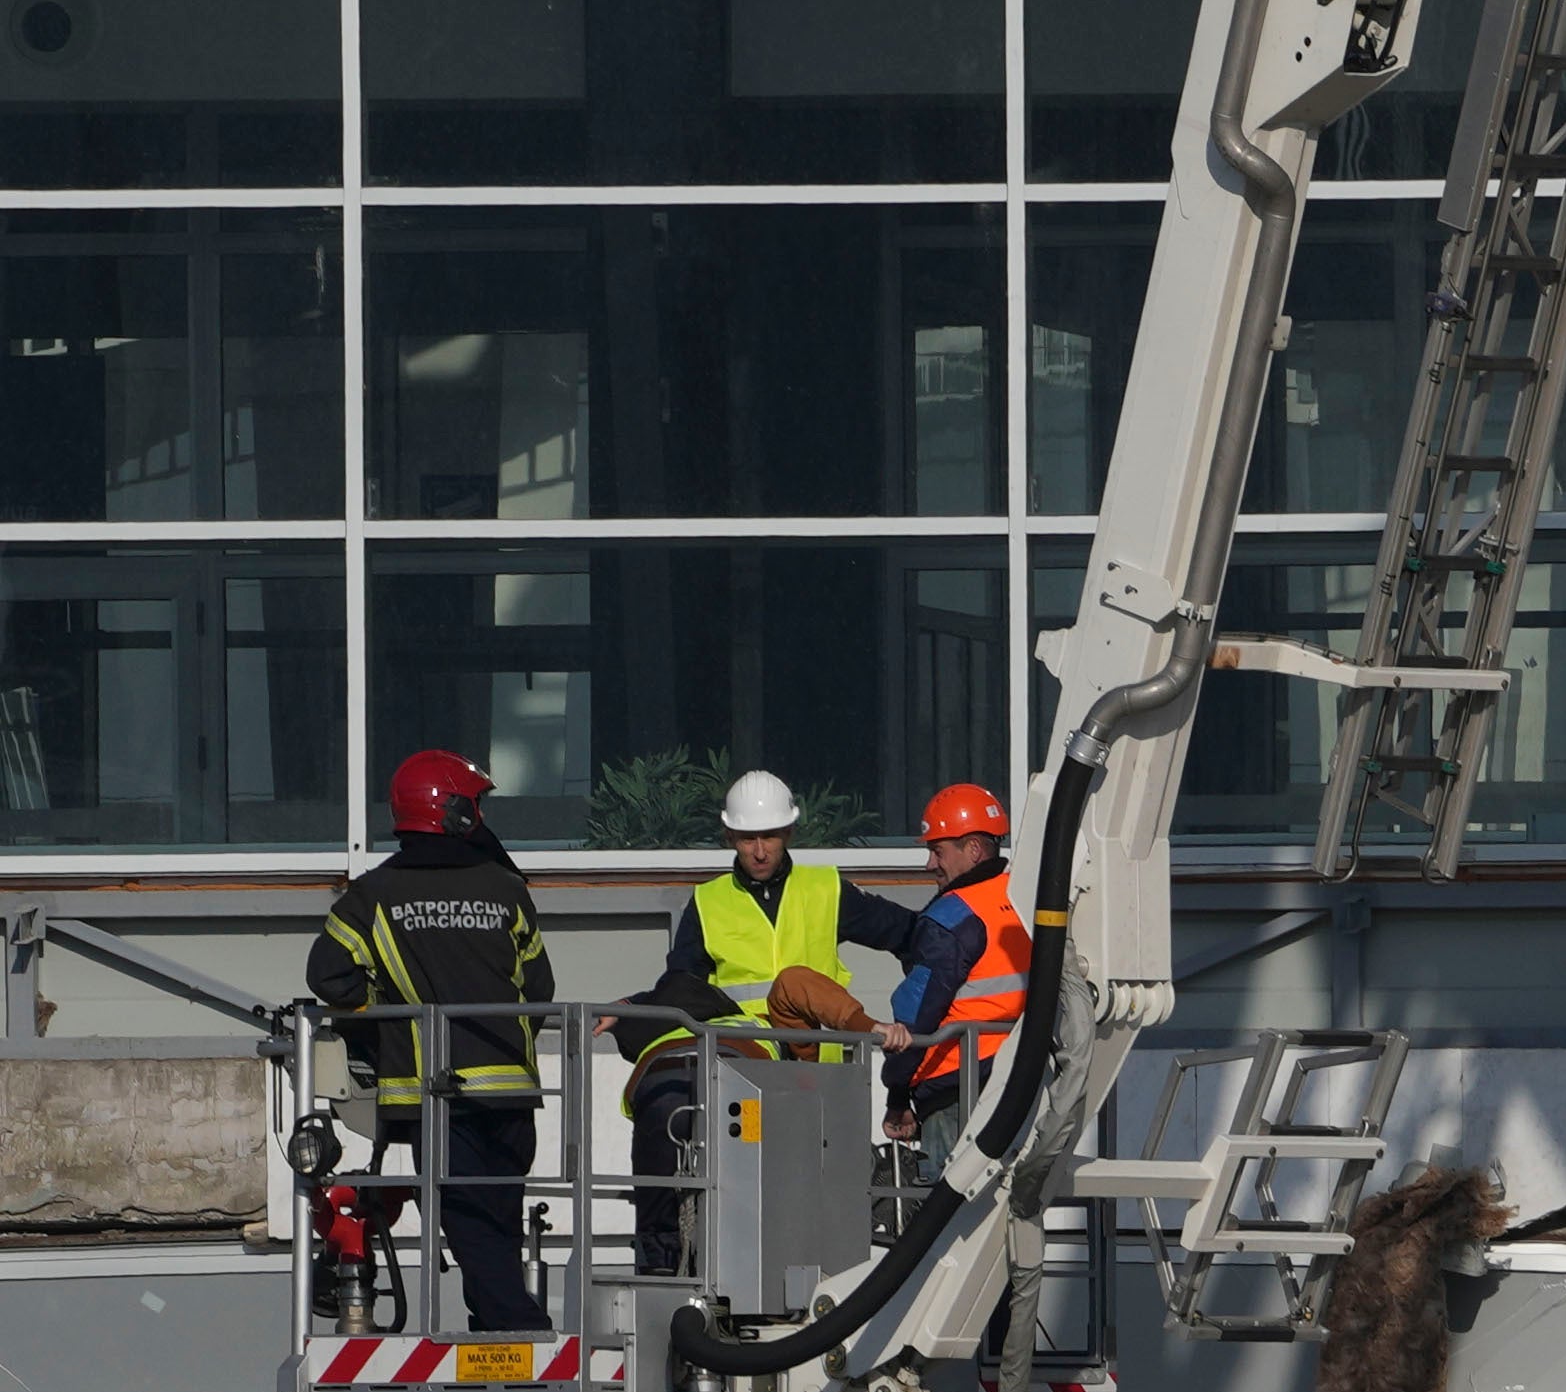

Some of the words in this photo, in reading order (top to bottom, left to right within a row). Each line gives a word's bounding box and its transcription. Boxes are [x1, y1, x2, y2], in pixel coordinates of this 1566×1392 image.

[391, 901, 510, 920] ВАТРОГАСЦИ
[403, 915, 502, 931] СПАСИОЦИ
[468, 1354, 487, 1363] MAX
[490, 1353, 505, 1363] 500
[508, 1353, 521, 1363] KG
